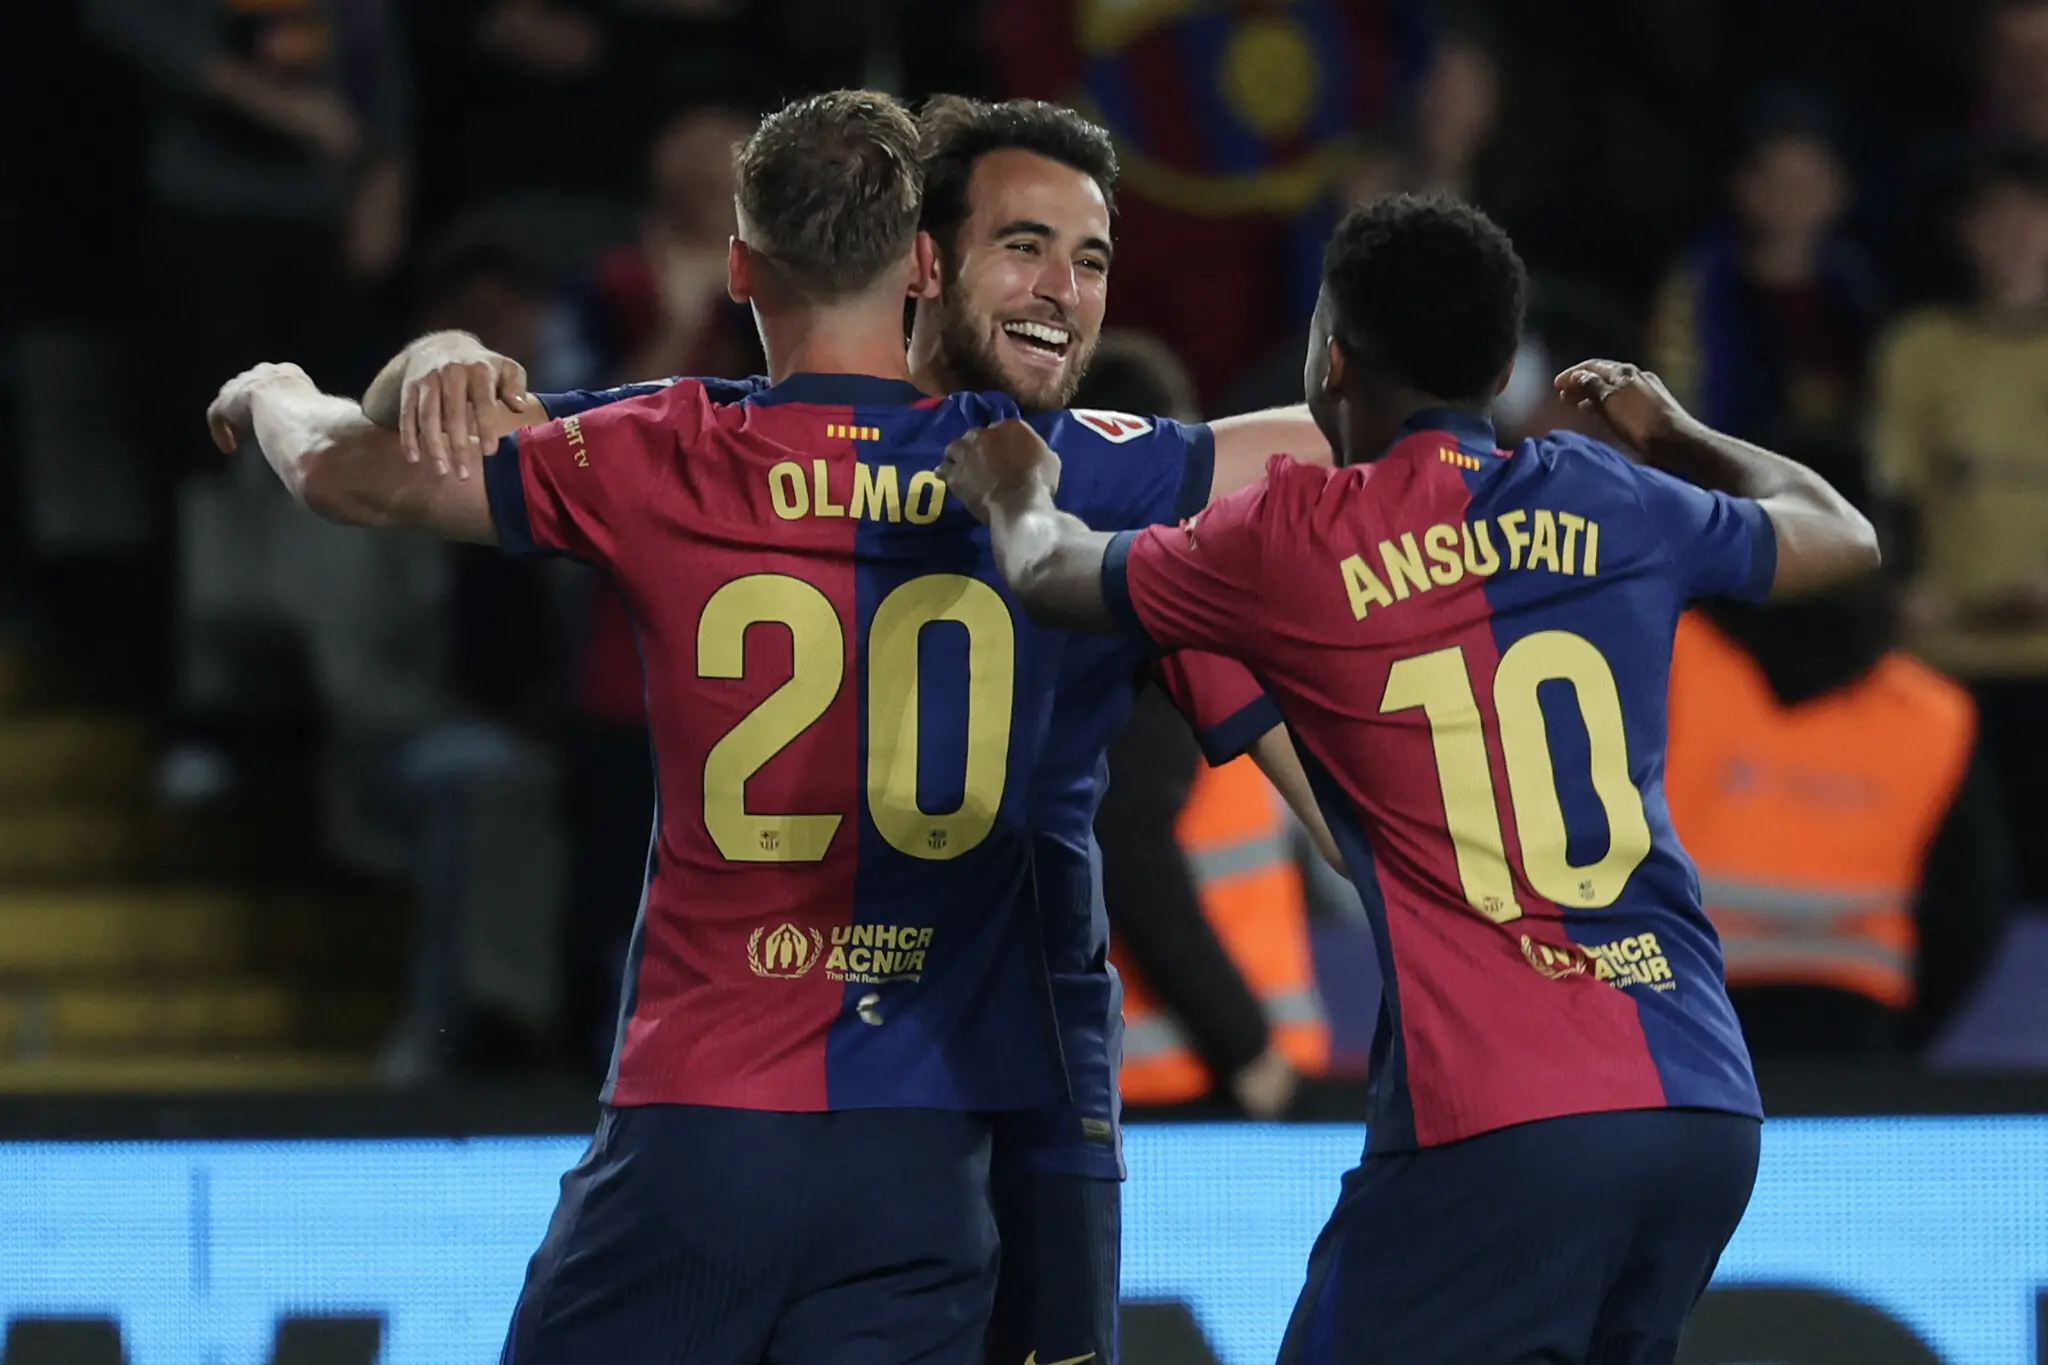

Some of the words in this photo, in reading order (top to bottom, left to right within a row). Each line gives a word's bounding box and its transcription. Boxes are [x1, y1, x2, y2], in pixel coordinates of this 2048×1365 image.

[769, 460, 946, 525] OLMO
[1339, 520, 1500, 620] ANSU
[1498, 509, 1600, 577] FATI
[697, 573, 1015, 862] 20
[1379, 629, 1652, 925] 10
[825, 946, 925, 973] ACNUR
[831, 925, 933, 949] UNHCR
[846, 973, 859, 983] UN
